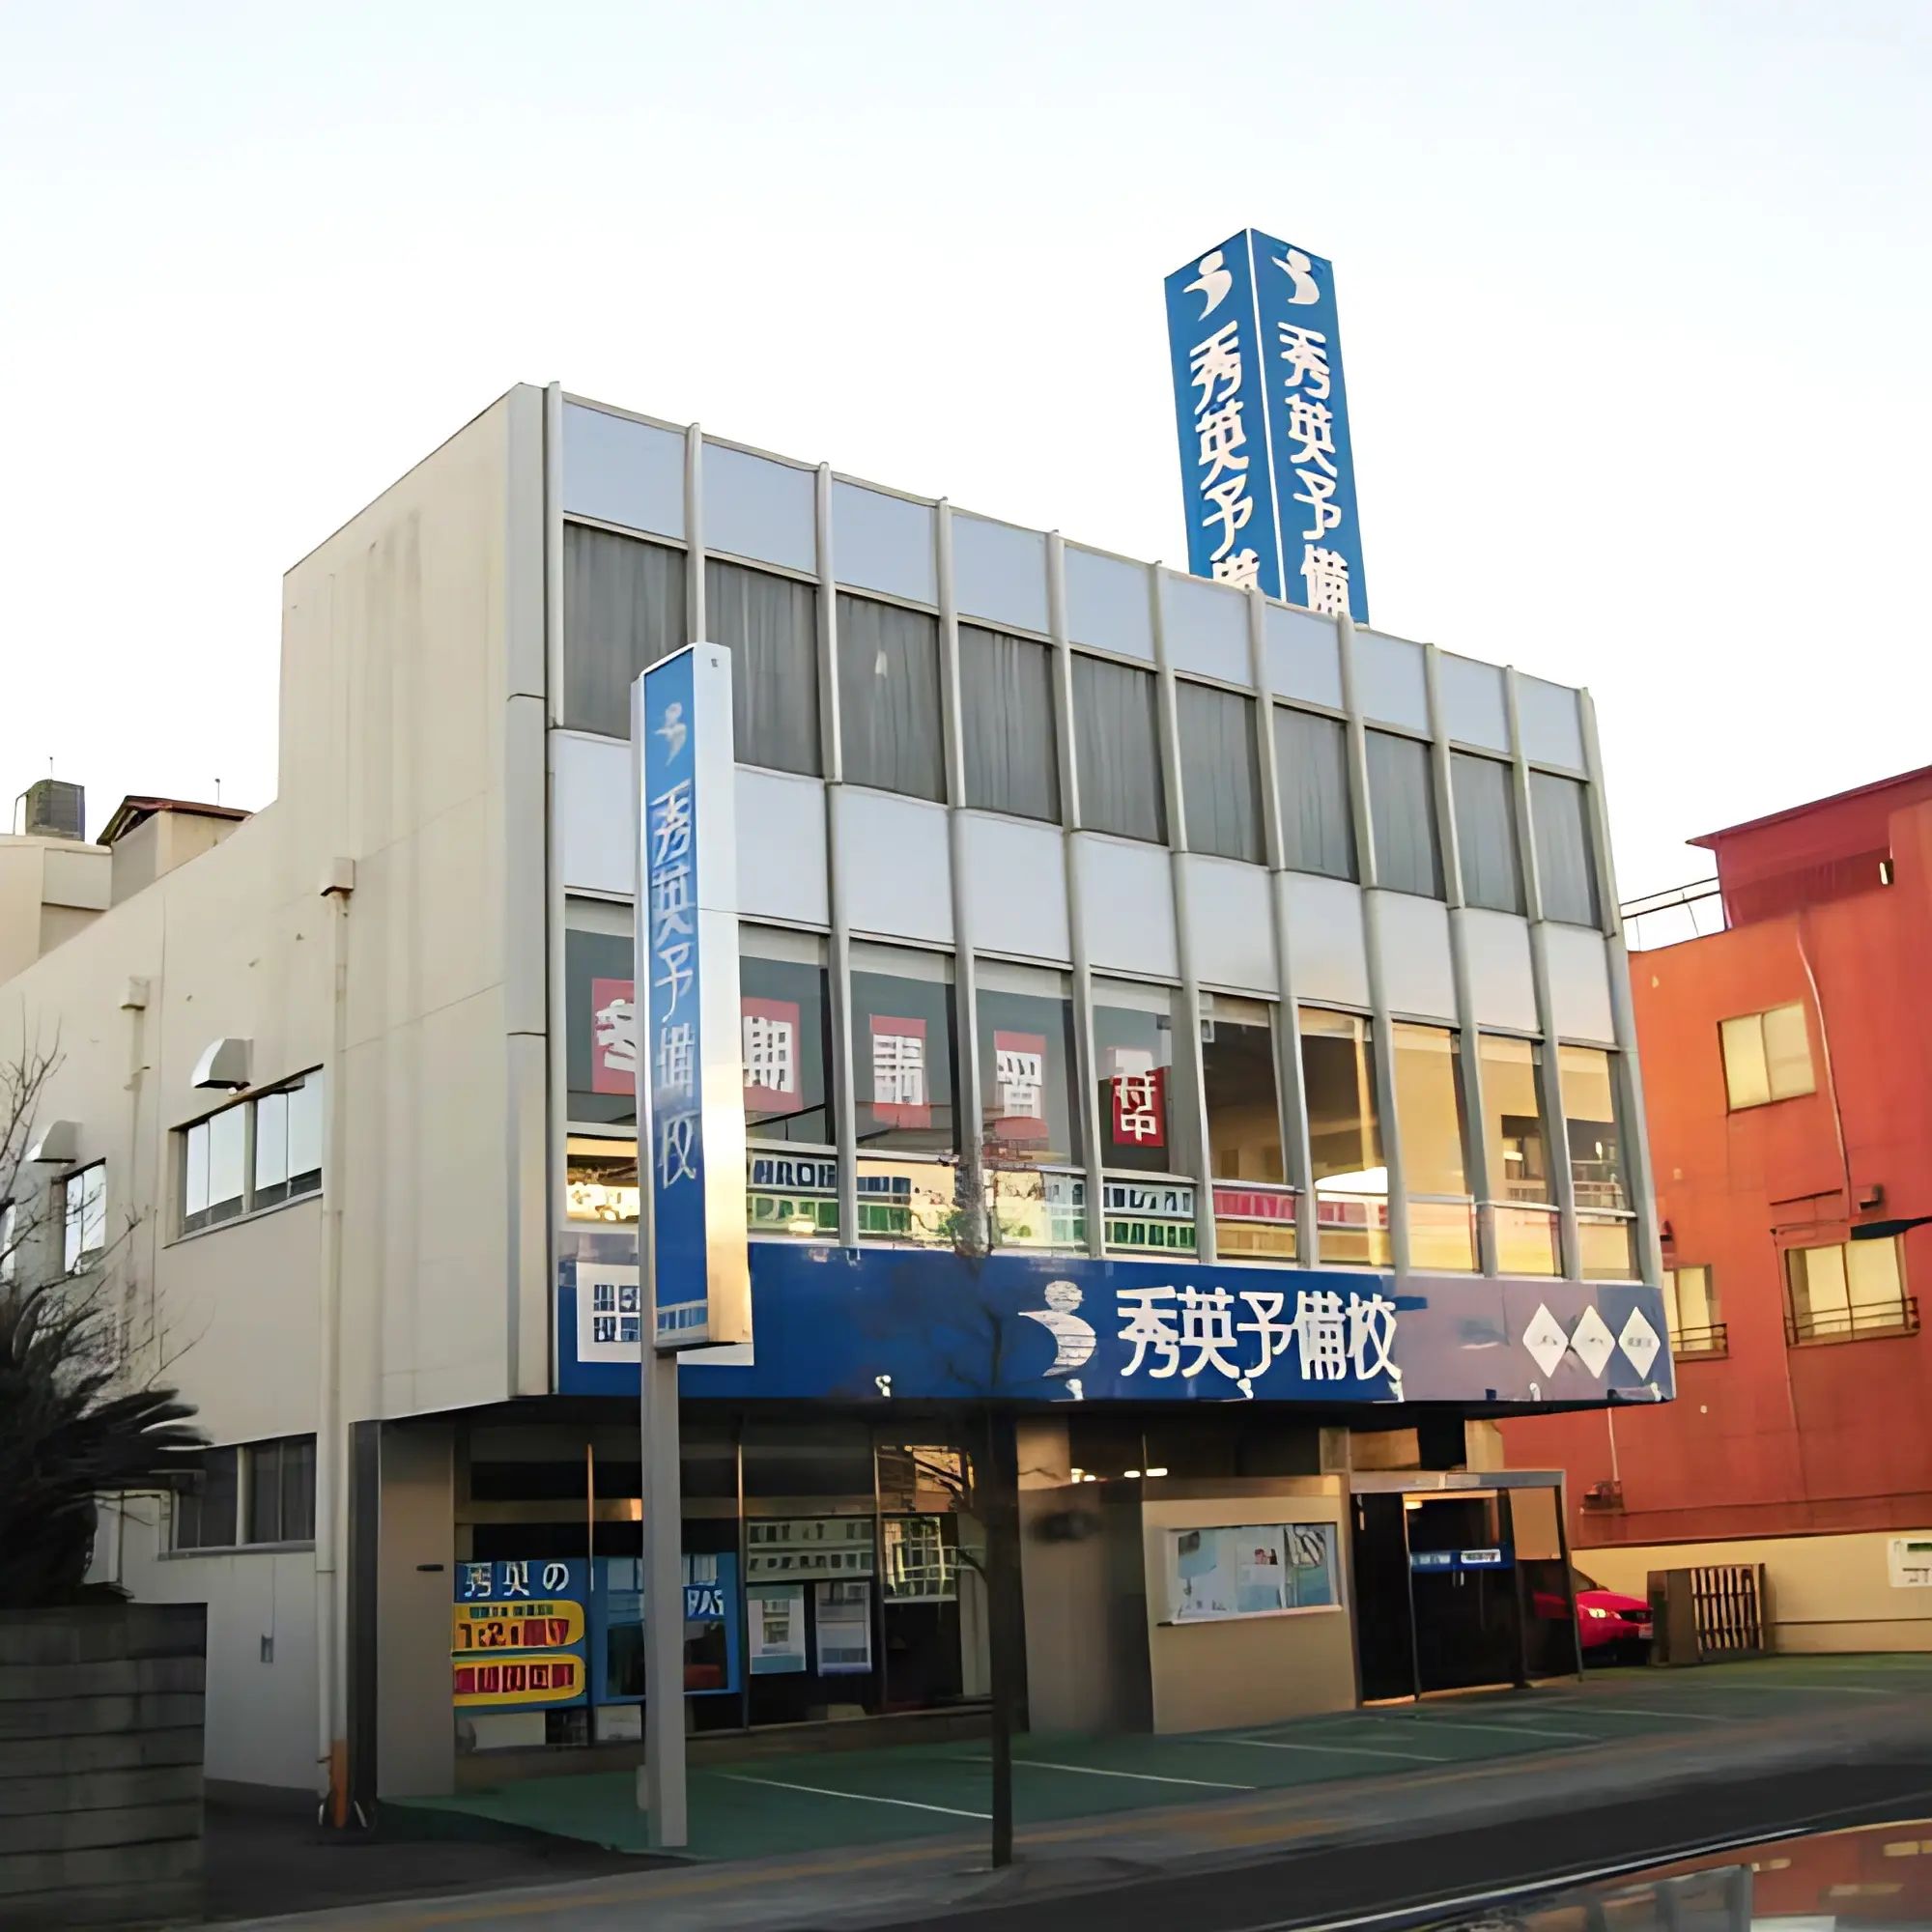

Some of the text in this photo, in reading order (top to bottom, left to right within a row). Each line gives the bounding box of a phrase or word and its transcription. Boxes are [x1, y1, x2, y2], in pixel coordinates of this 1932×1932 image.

[1116, 1285, 1403, 1380] 秀英予備校
